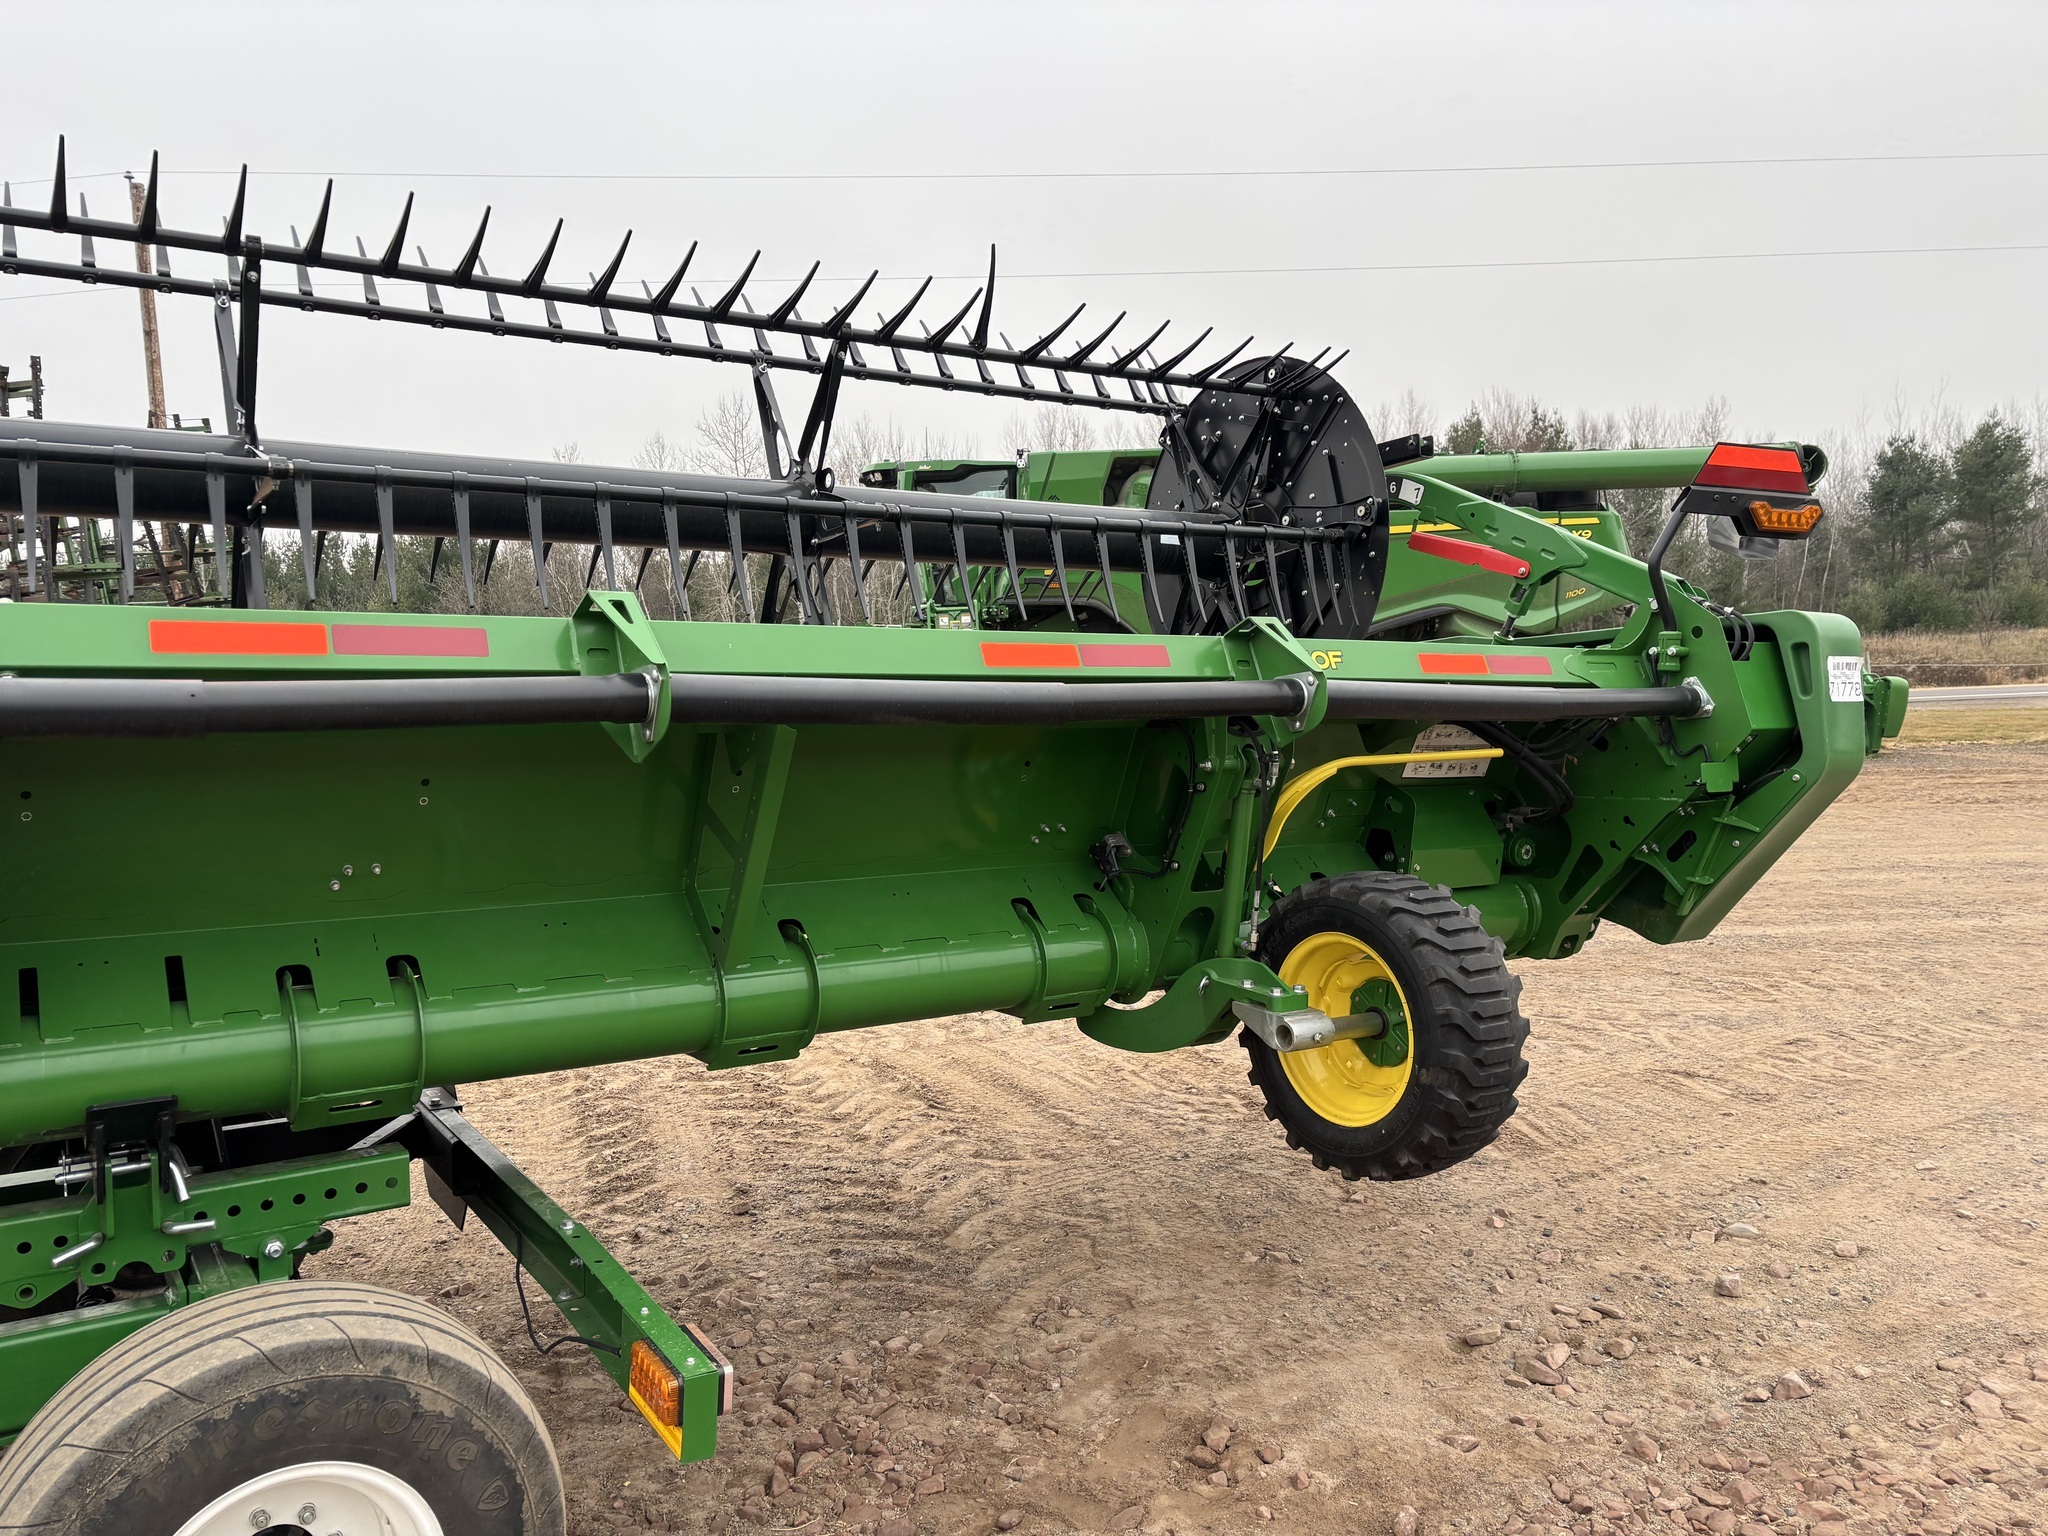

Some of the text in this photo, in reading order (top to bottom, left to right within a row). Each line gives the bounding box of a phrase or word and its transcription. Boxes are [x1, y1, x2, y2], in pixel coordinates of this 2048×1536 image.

[1390, 481, 1421, 499] 6 7
[1571, 529, 1592, 540] X9
[1565, 587, 1586, 599] 1100
[1830, 681, 1861, 697] 71778
